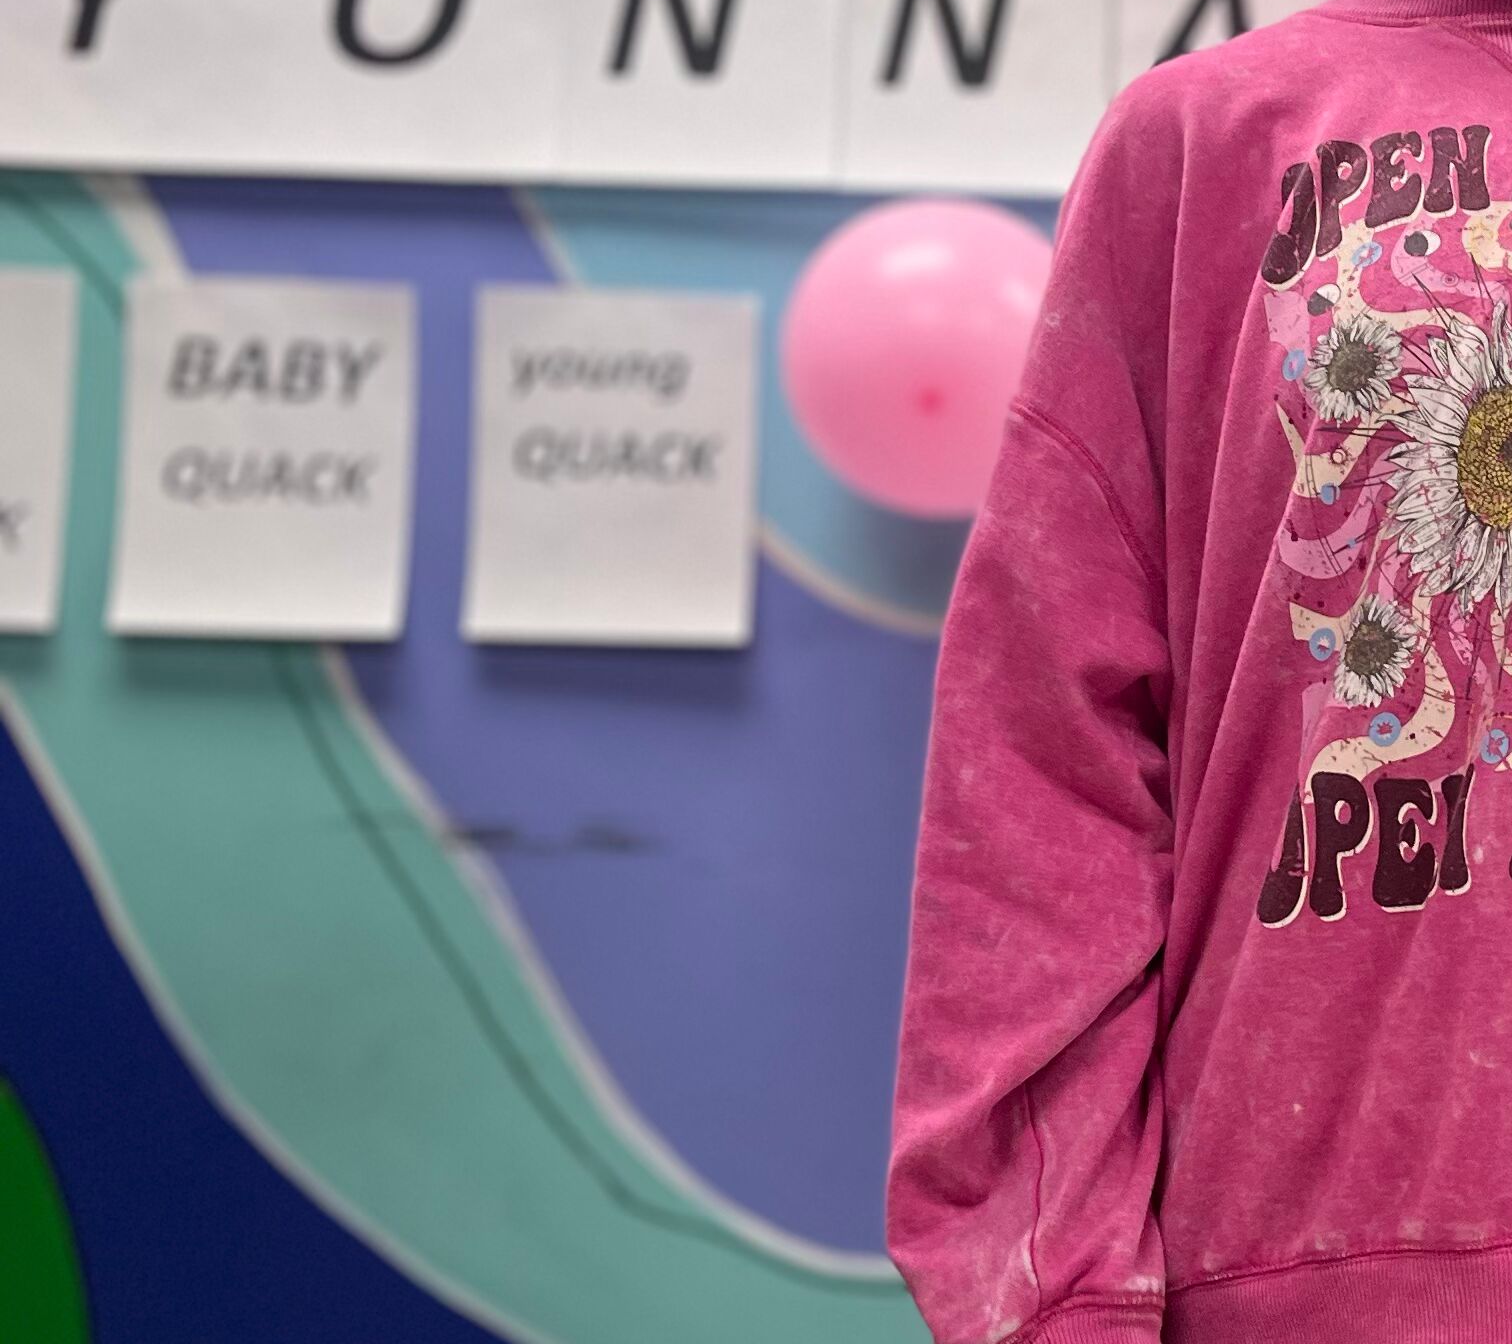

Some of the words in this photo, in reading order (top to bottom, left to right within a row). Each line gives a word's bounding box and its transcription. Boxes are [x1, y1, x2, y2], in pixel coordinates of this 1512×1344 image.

[165, 332, 385, 406] BABY
[510, 346, 692, 408] young
[159, 445, 378, 506] QUACK
[511, 423, 725, 486] QUACK
